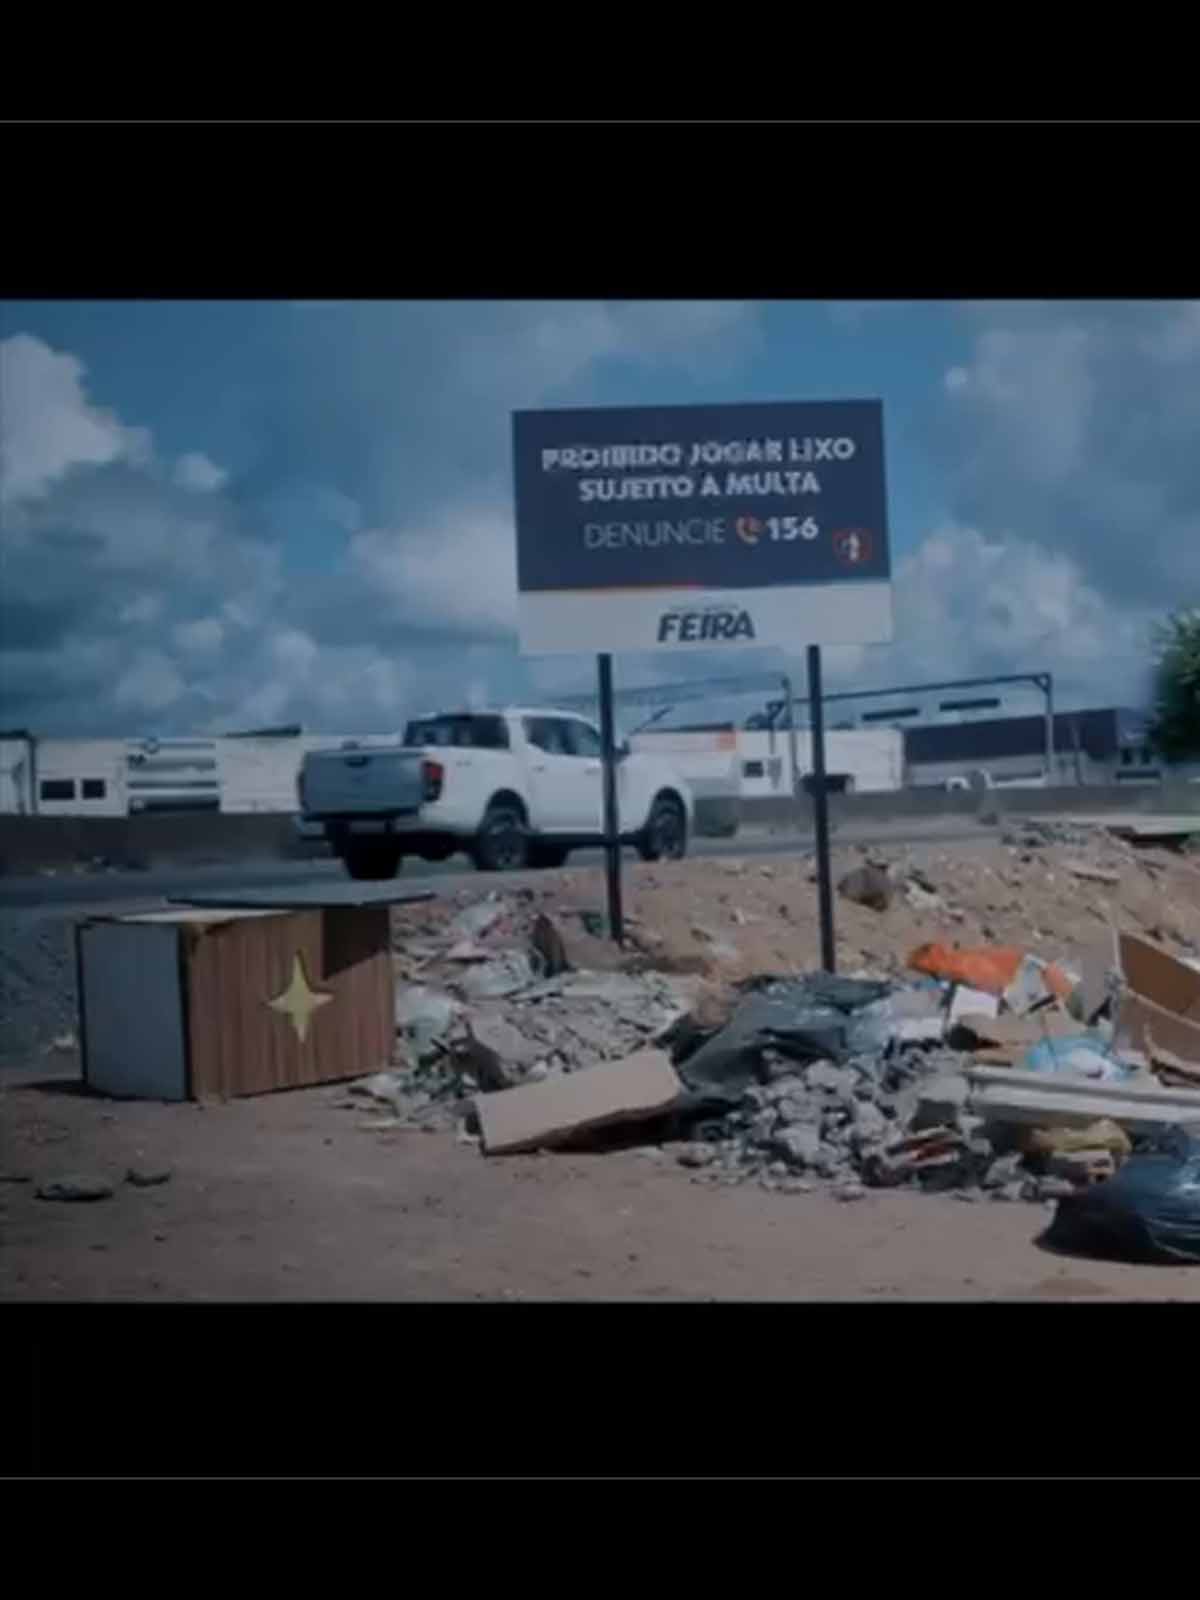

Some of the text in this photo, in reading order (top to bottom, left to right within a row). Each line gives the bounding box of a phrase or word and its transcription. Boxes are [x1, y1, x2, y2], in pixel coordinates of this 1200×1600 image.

[690, 440, 782, 466] JOGAR
[790, 437, 856, 461] LIXO
[578, 471, 821, 502] SUJEITO A MULTA
[584, 516, 819, 548] DENUNCIE 156
[657, 610, 755, 642] FEIRA
